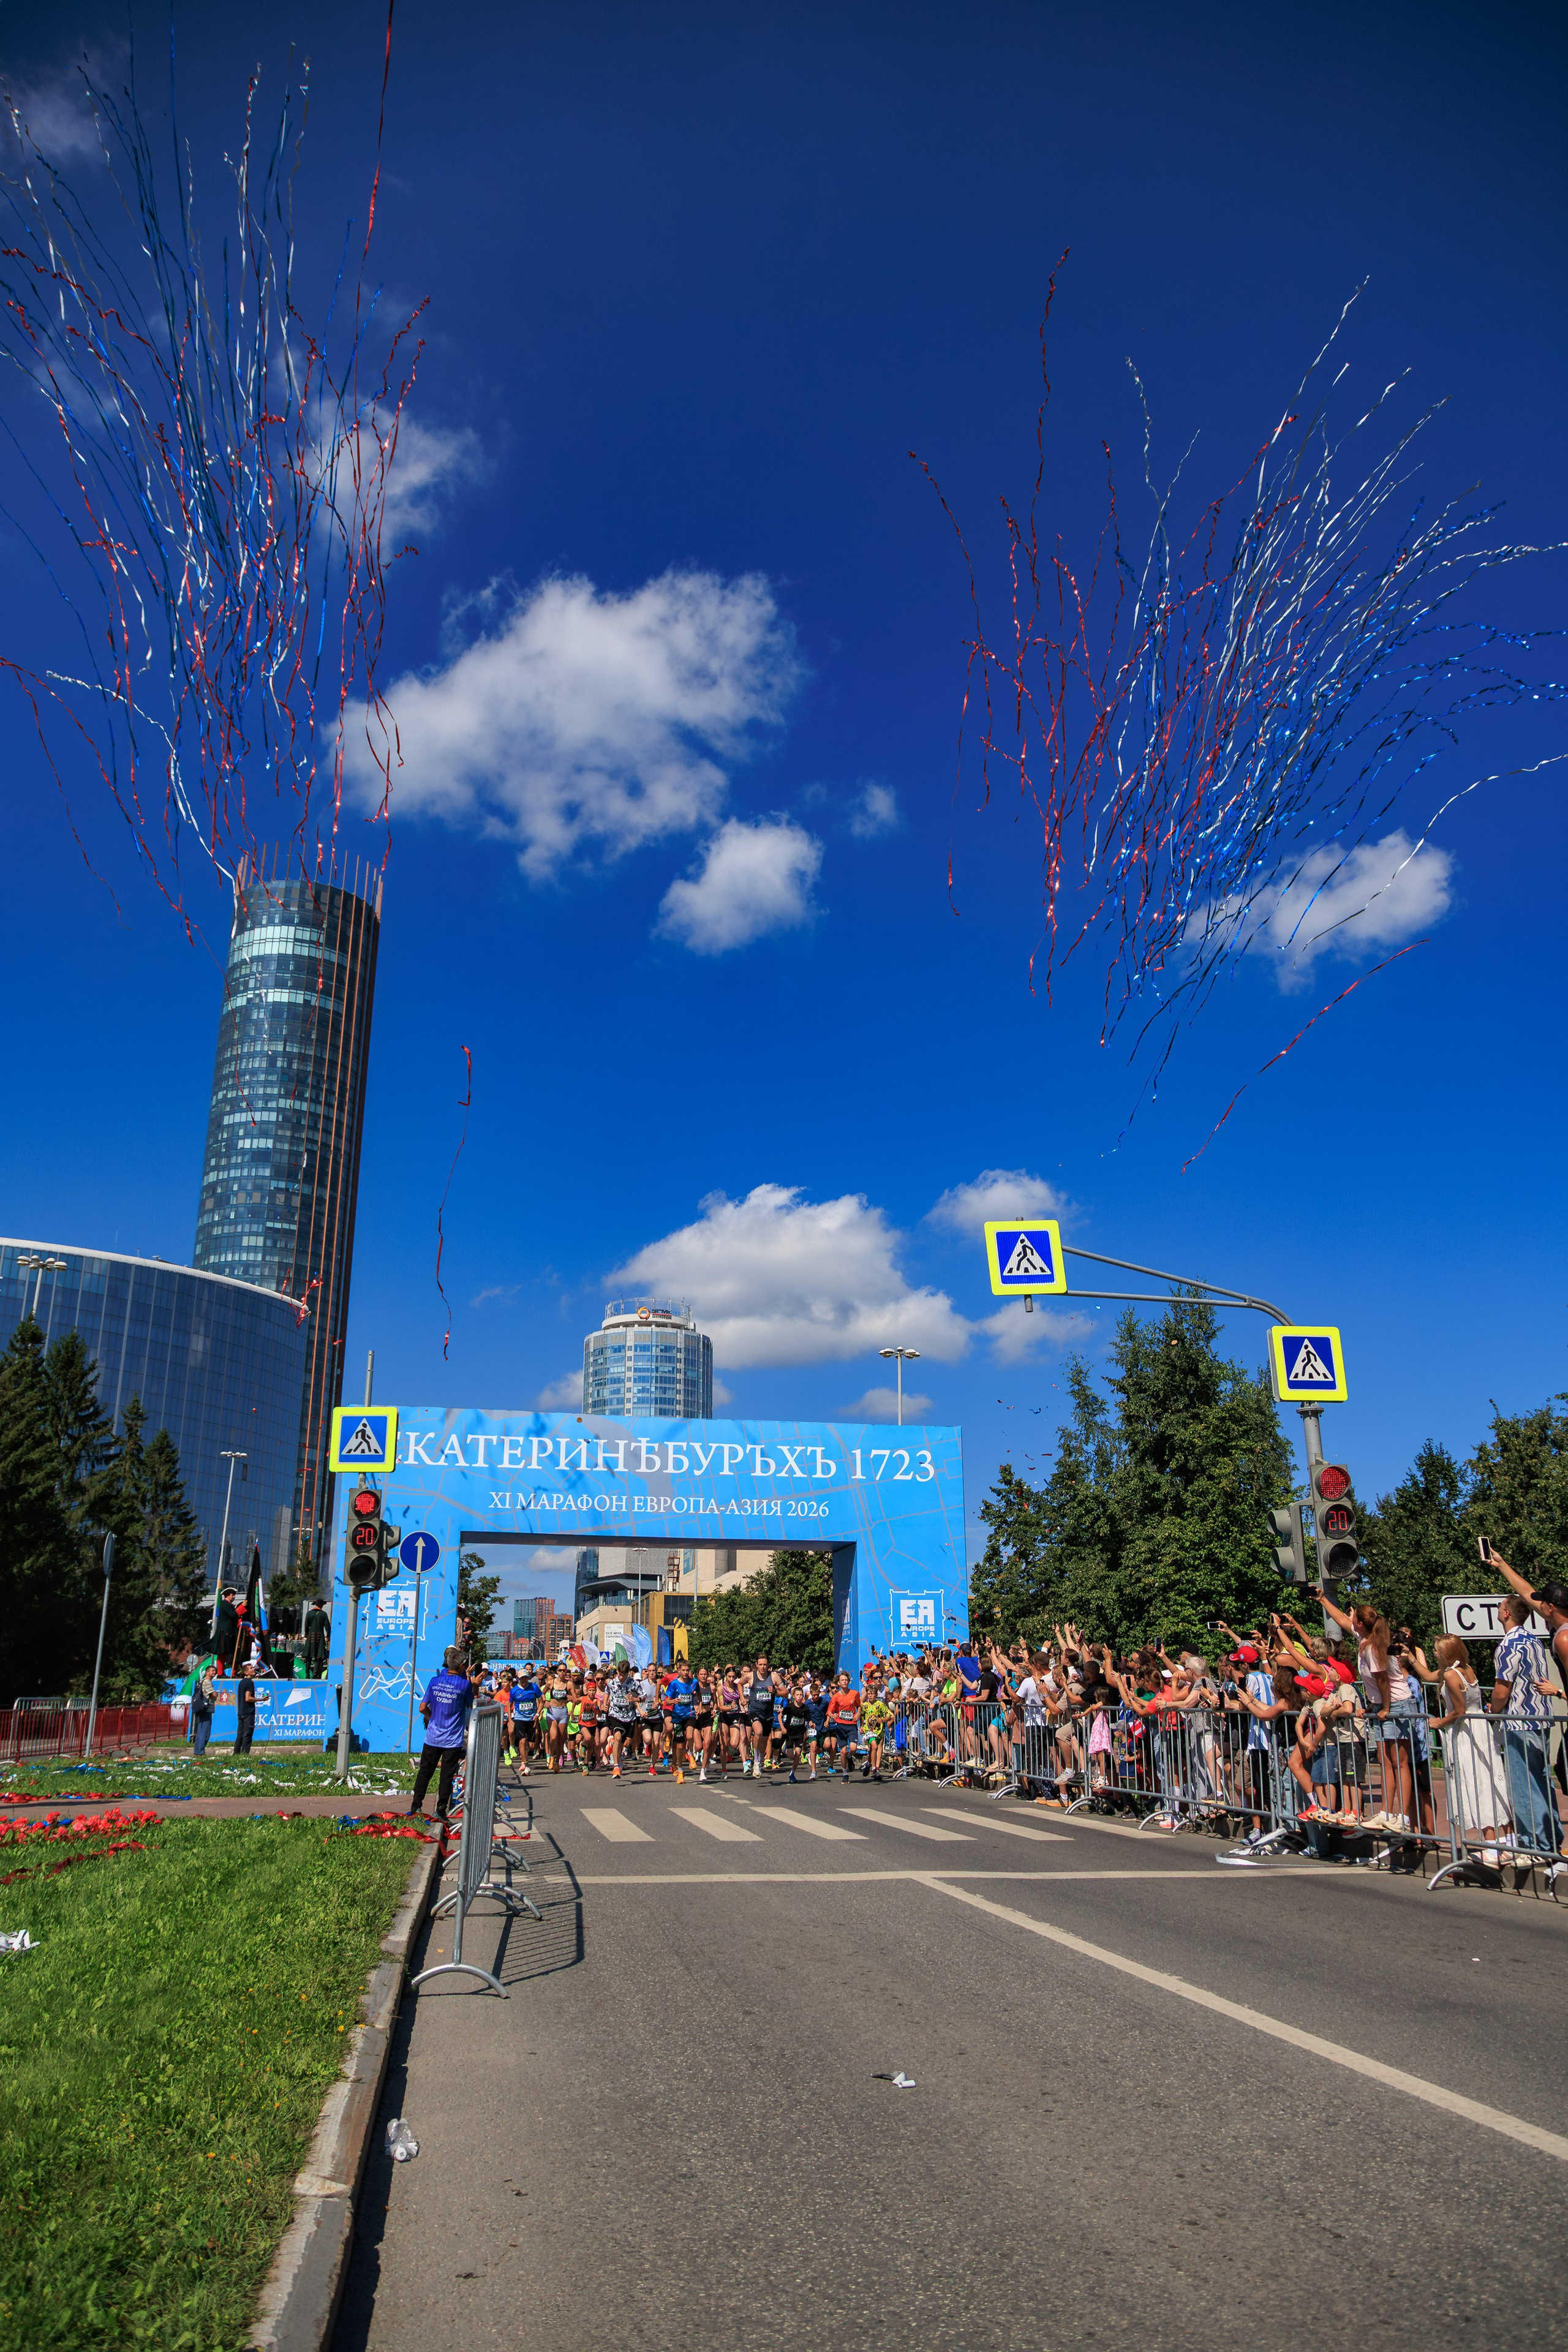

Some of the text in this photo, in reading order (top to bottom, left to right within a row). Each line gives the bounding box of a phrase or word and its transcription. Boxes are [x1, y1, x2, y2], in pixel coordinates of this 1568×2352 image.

[396, 1431, 935, 1482] КАТЕРИНѢБУРЪХЪ 1723
[488, 1491, 829, 1517] XI МАРАФОН ЕВРОПА-АЗИЯ 2026
[1329, 1511, 1348, 1530] 20
[356, 1528, 374, 1545] 20
[433, 1691, 457, 1699] ГЛАВНЫЙ
